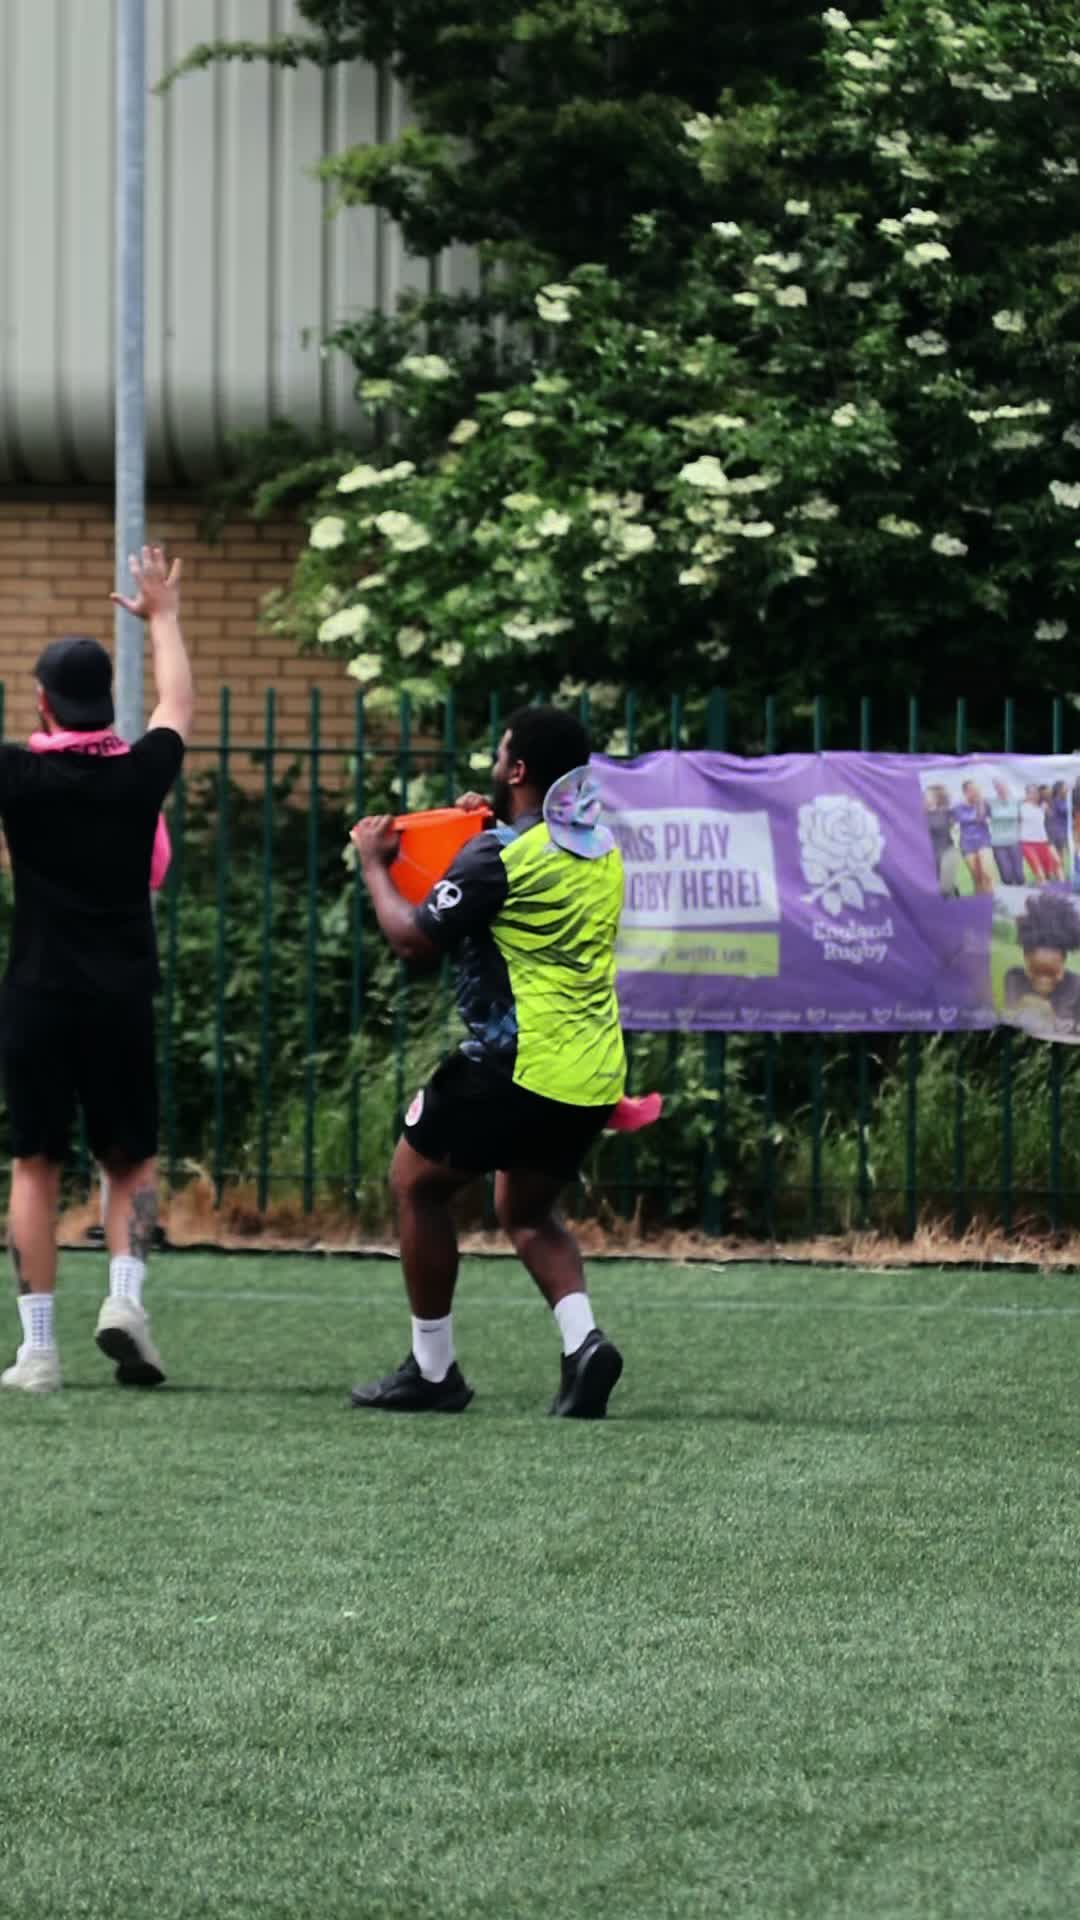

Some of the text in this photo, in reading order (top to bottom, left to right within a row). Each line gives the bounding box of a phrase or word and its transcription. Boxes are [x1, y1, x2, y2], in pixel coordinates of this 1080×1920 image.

[663, 822, 730, 861] PLAY
[680, 869, 762, 909] HERE!
[812, 918, 894, 942] England
[823, 941, 888, 965] Rugby
